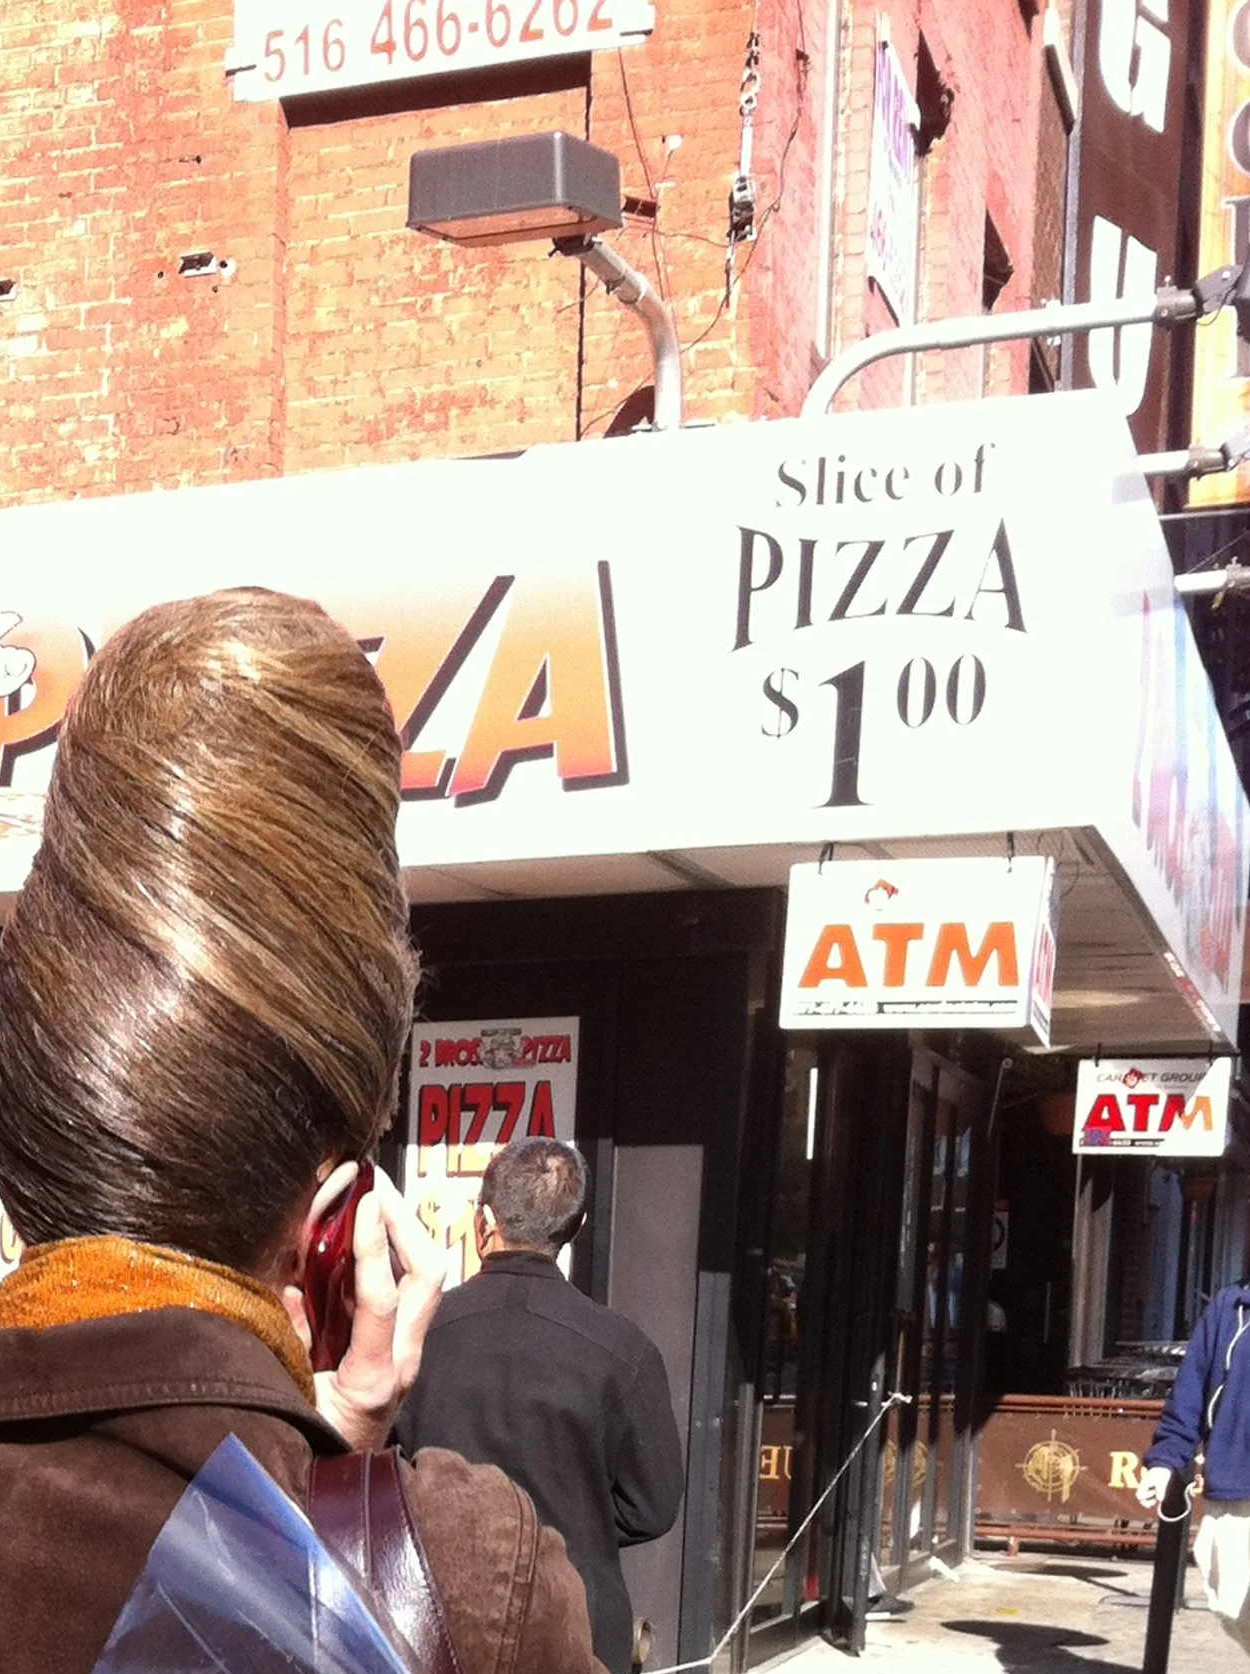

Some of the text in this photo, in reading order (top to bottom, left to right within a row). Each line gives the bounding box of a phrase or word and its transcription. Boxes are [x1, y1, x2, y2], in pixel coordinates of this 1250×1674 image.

[264, 19, 345, 82] 516
[776, 442, 996, 508] Slice of
[727, 517, 1028, 654] PIZZA
[797, 921, 1020, 988] ATM
[1081, 1094, 1213, 1132] ATM
